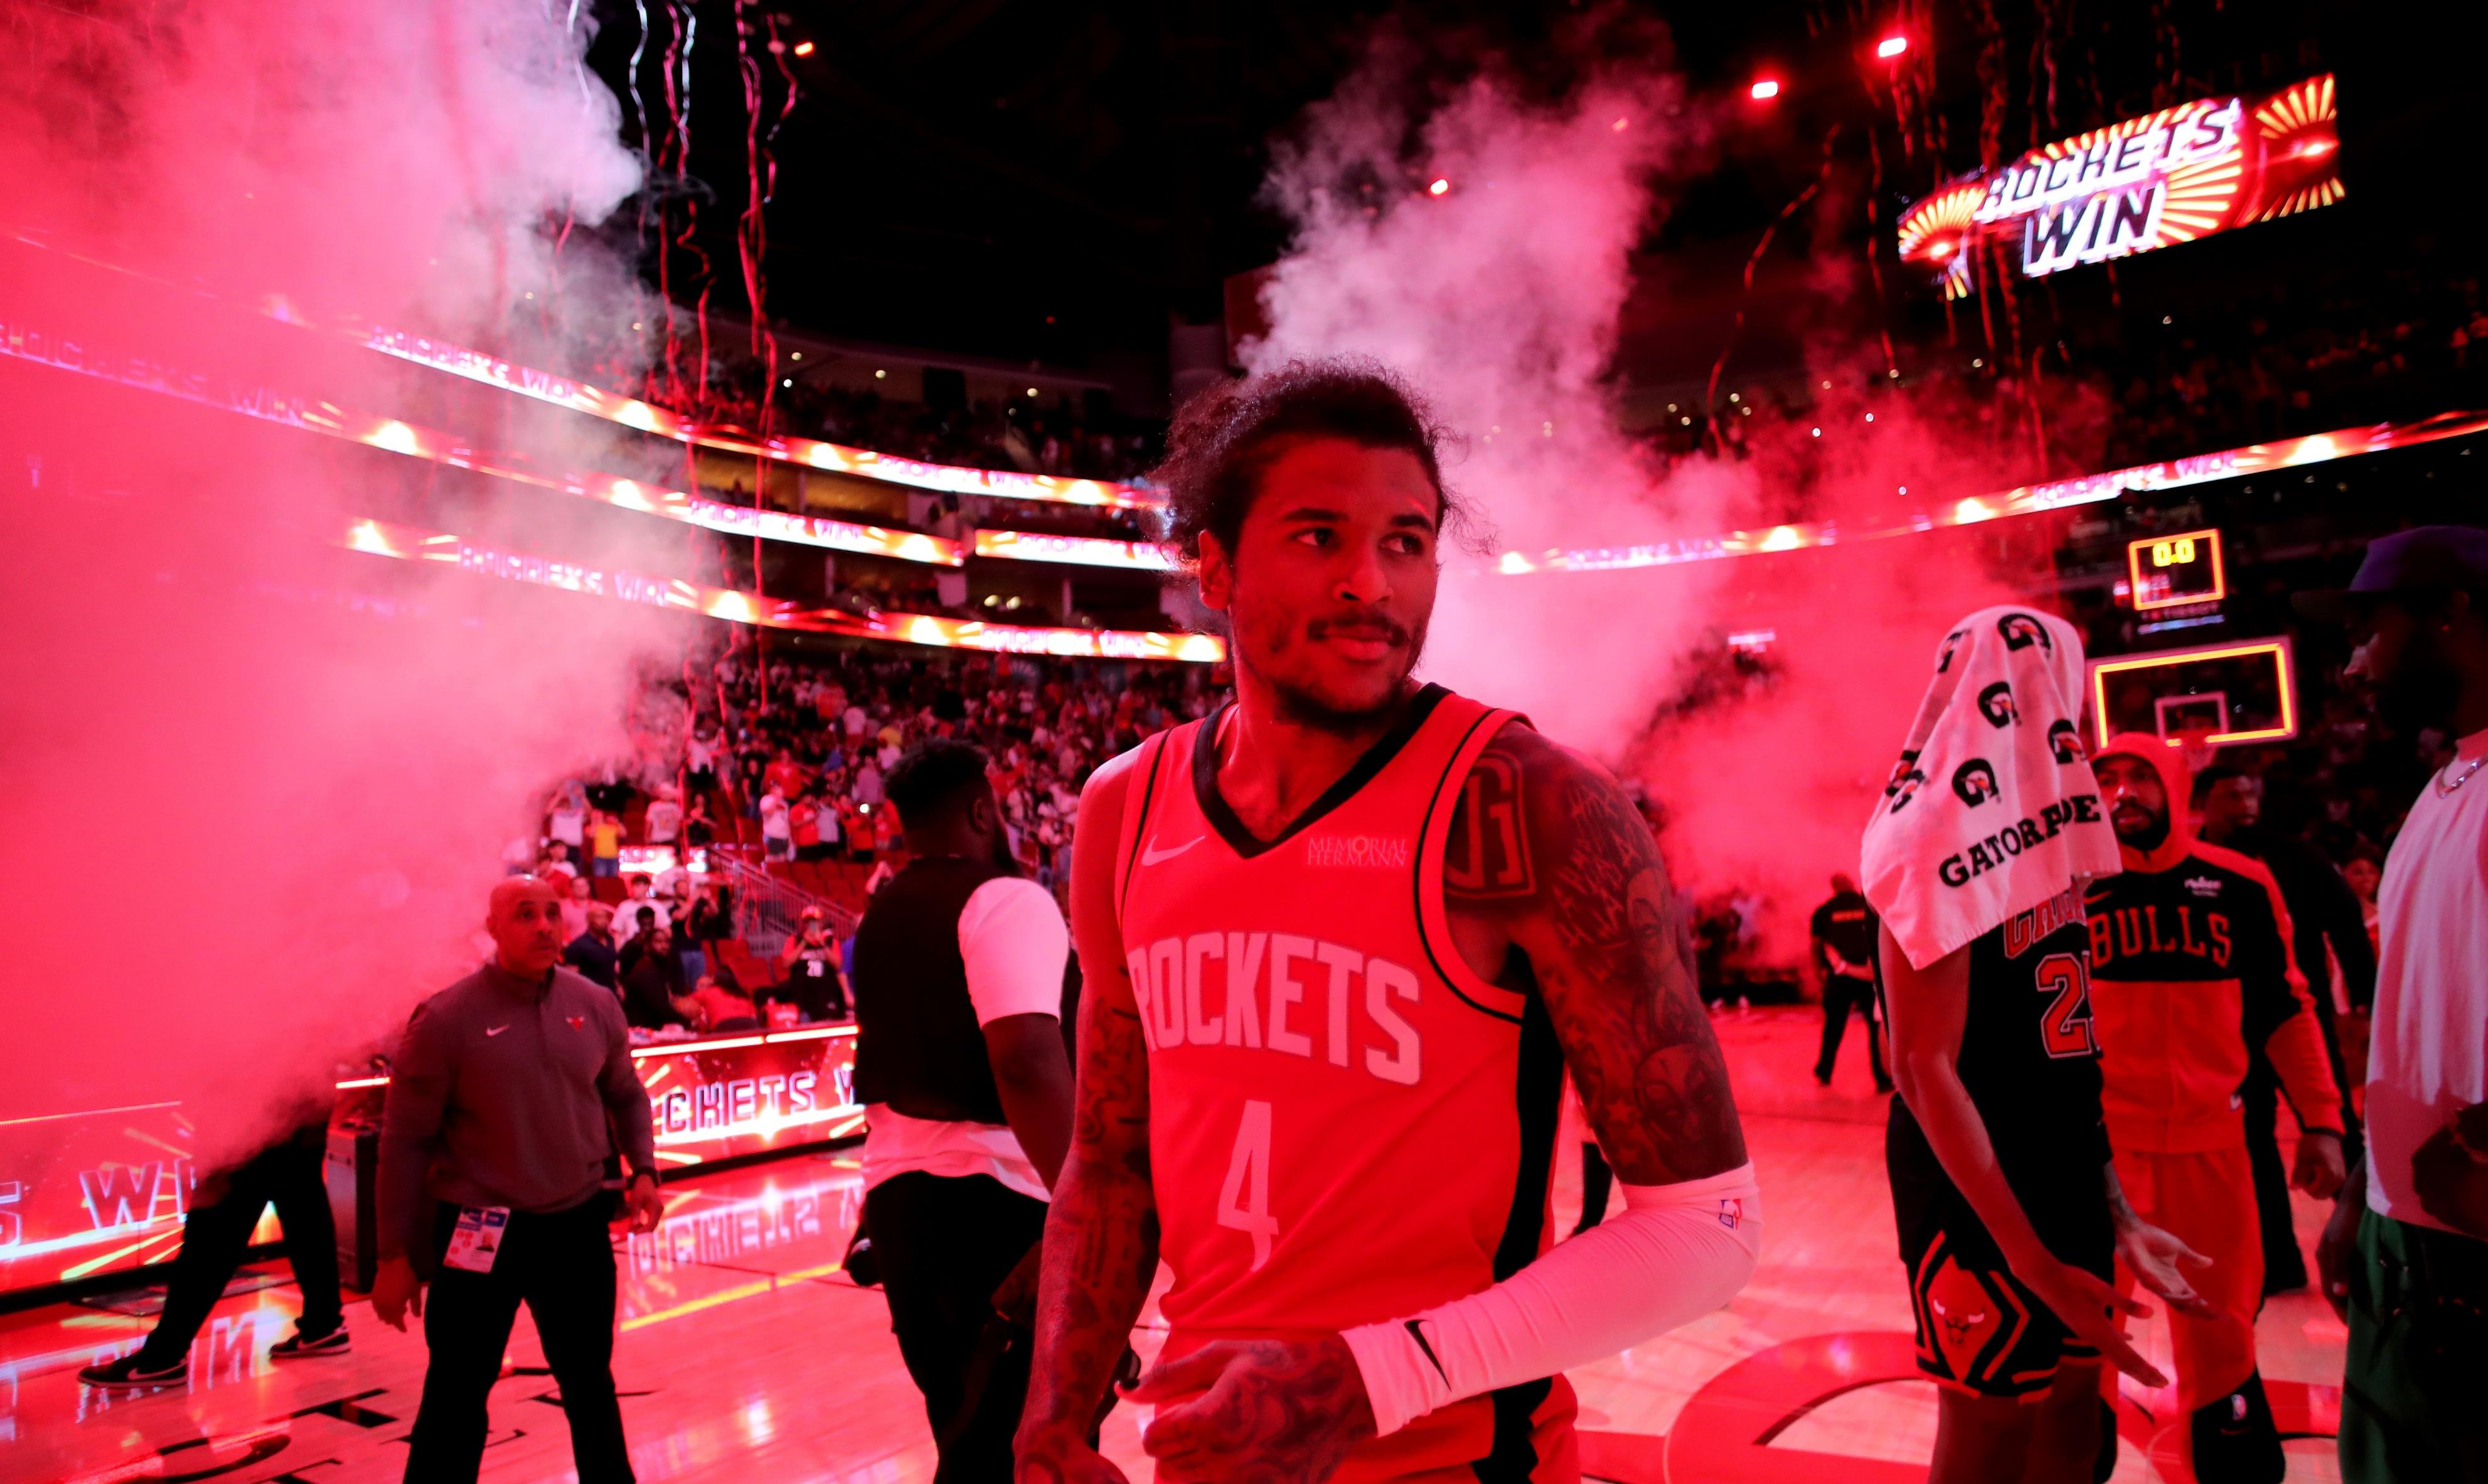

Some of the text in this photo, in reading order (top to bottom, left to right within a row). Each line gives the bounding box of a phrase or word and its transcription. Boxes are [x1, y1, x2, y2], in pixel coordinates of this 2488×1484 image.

[1973, 97, 2241, 223] ROCKETS
[2023, 180, 2168, 277] WIN
[2152, 538, 2195, 567] 0.0
[1307, 849, 1406, 867] HERMANN
[1308, 835, 1408, 854] MEMORIAL
[2088, 905, 2232, 969] BULLS
[1128, 931, 1421, 1086] ROCKETS
[2035, 950, 2100, 1059] 2
[1217, 1099, 1279, 1273] 4
